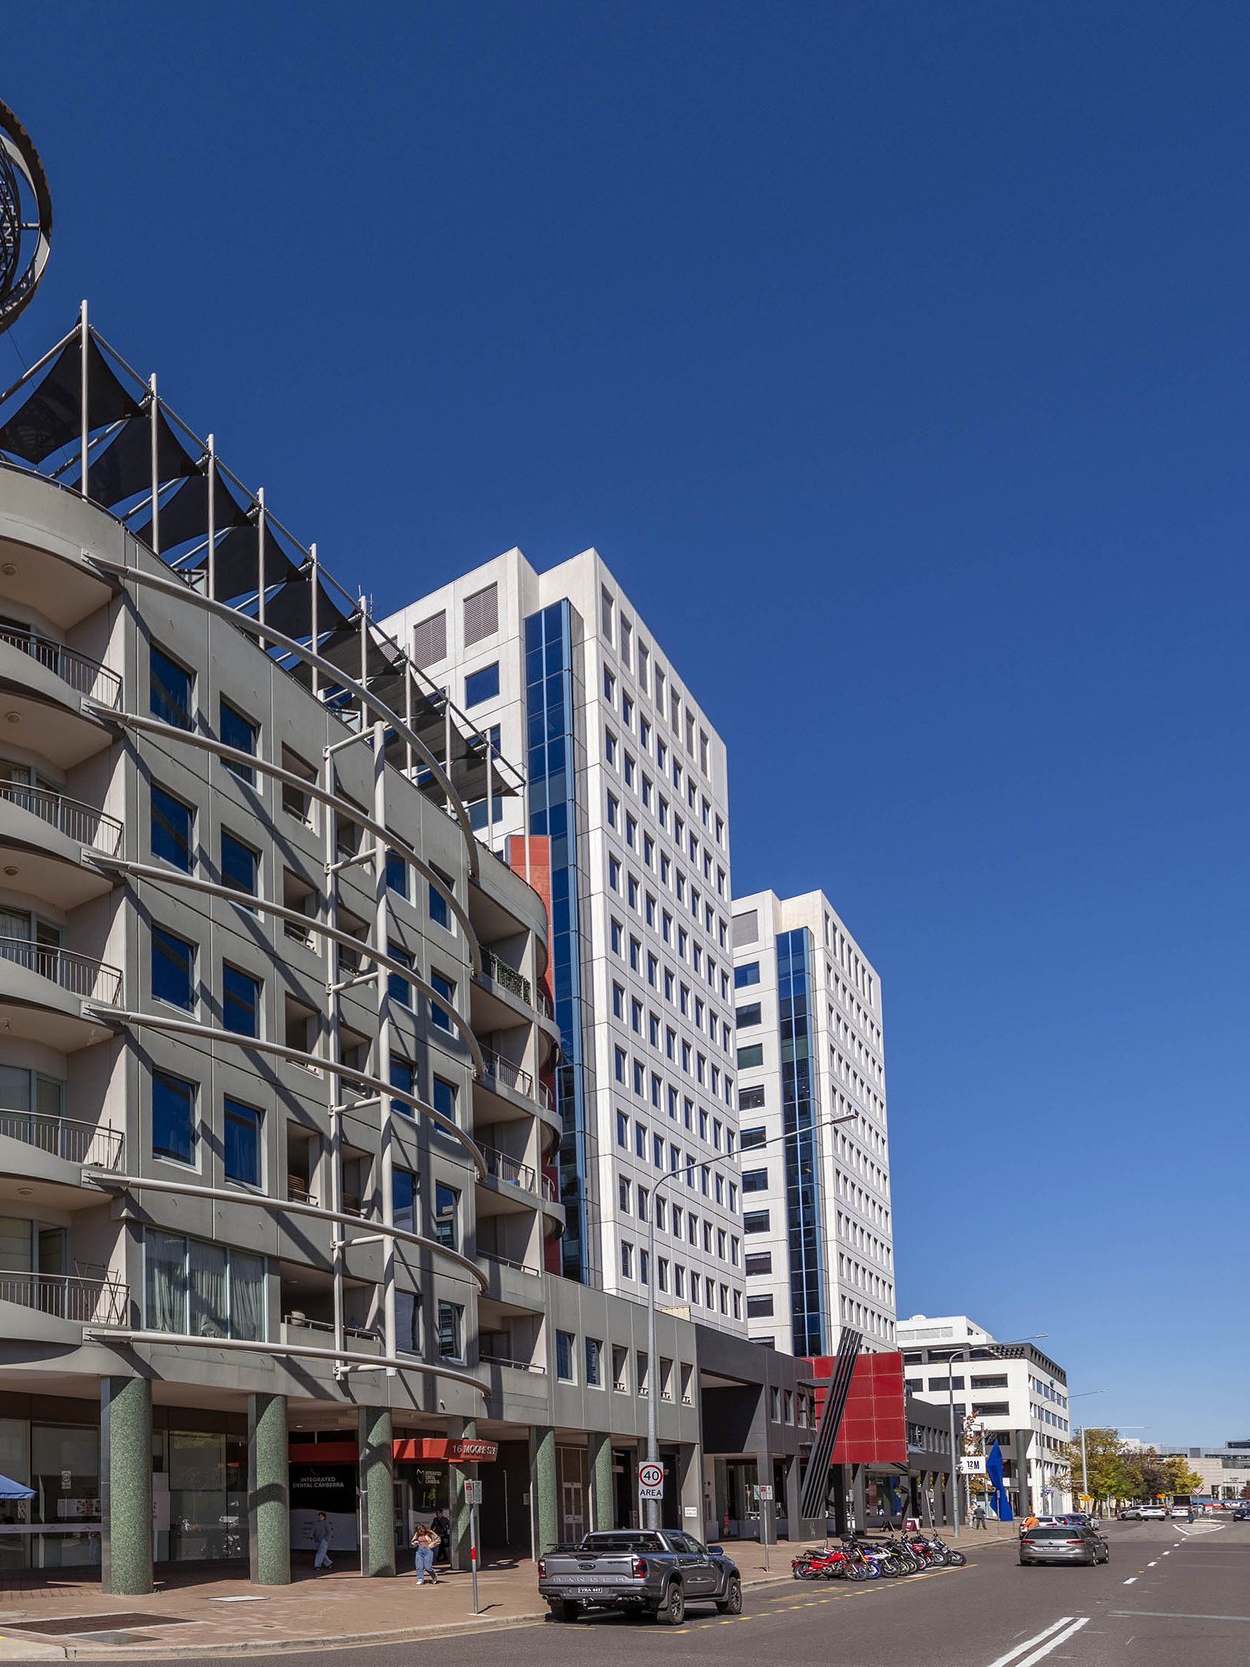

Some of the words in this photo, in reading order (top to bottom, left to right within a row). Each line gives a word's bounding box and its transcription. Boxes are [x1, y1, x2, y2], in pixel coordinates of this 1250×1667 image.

[452, 1444, 462, 1453] 16
[643, 1470, 660, 1481] 40
[639, 1488, 662, 1497] AREA
